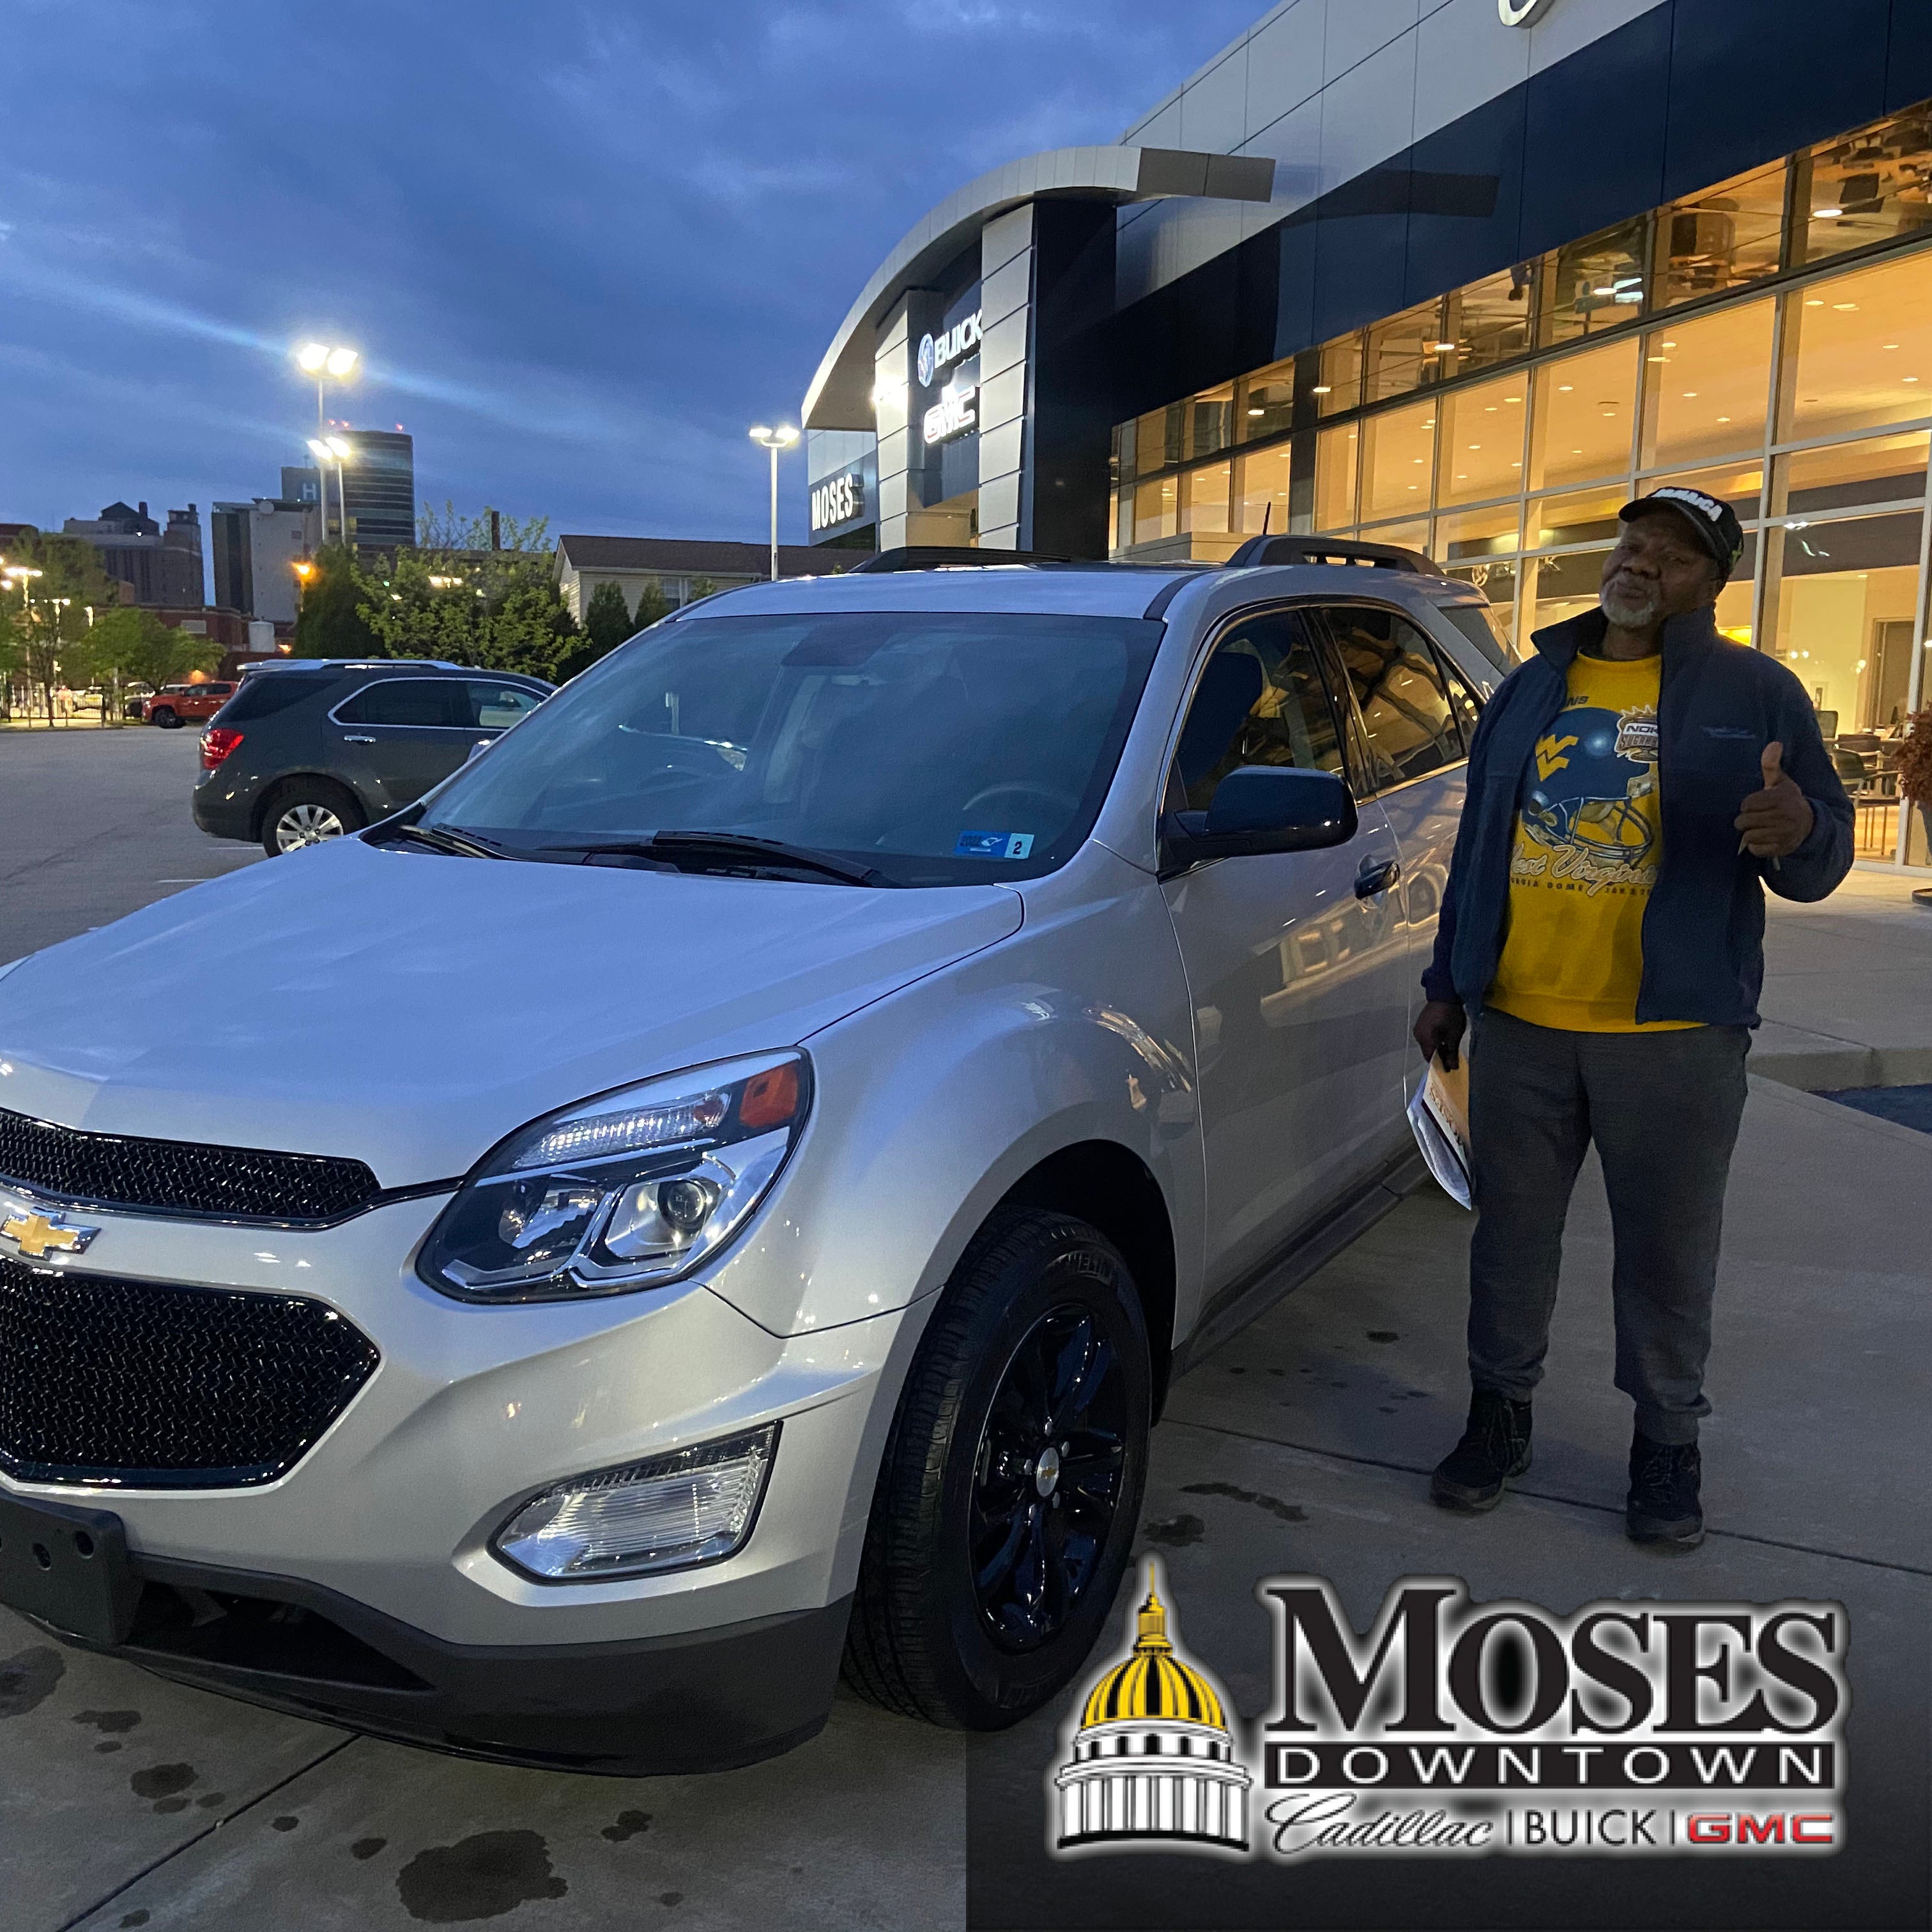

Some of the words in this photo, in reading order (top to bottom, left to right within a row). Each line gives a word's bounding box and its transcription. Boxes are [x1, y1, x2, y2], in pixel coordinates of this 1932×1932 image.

[935, 309, 982, 368] BUICK
[924, 385, 976, 444] GMC
[811, 473, 853, 531] MOSES
[1012, 841, 1022, 854] 2
